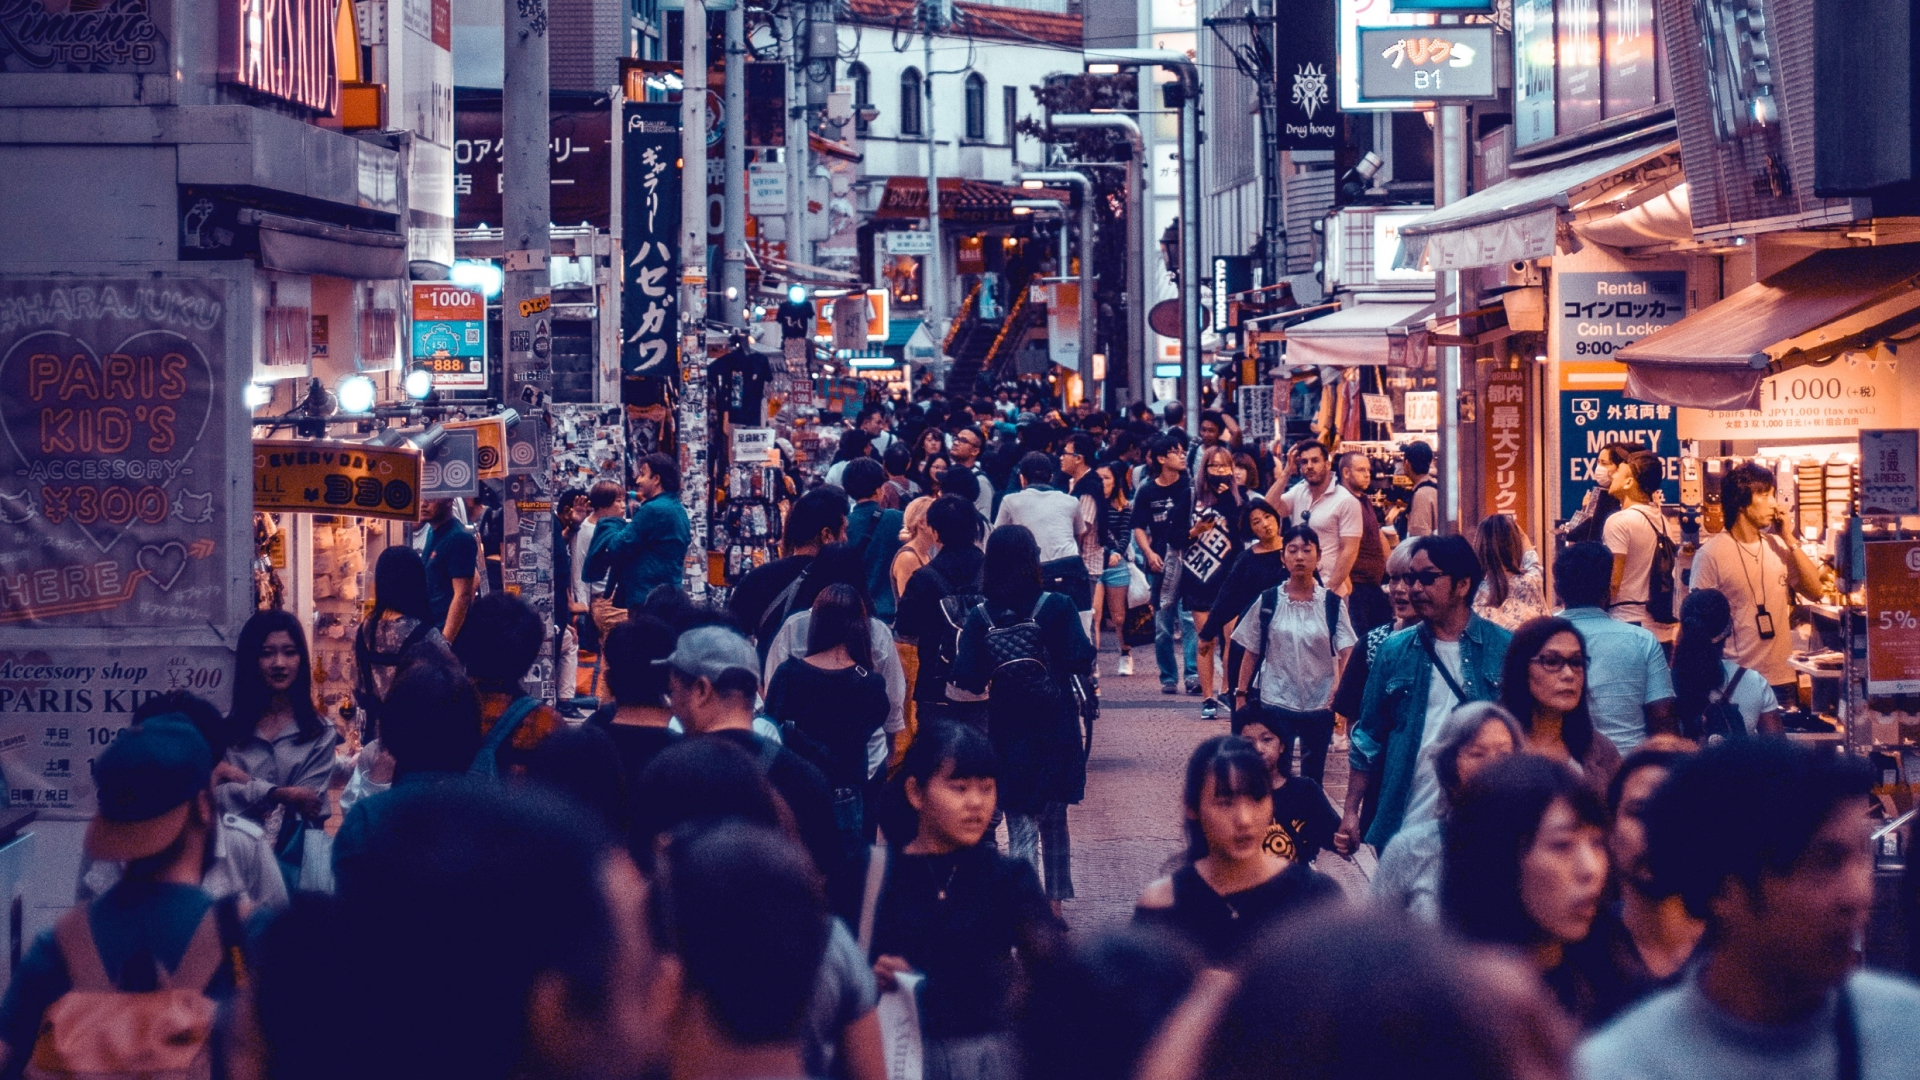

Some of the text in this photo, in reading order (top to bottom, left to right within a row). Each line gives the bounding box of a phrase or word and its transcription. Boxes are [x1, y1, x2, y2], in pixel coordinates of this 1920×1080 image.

[53, 43, 155, 64] TOKYO
[1414, 69, 1442, 90] B1
[1286, 122, 1336, 138] Drug honey
[1597, 281, 1647, 295] Rental
[430, 291, 471, 306] 1000
[1564, 300, 1683, 319] コインロッカー
[1577, 322, 1613, 336] Coin
[434, 359, 461, 371] 888
[29, 353, 188, 400] PARIS
[1488, 384, 1524, 403] 都内
[1607, 404, 1671, 420] 外貨両替
[41, 405, 176, 454] KID'S
[42, 485, 169, 524] ¥300
[167, 657, 188, 666] ALL
[0, 660, 148, 684] Accessory shop
[168, 668, 223, 688] ¥300
[0, 689, 94, 713] PARIS
[45, 728, 70, 740] 平日
